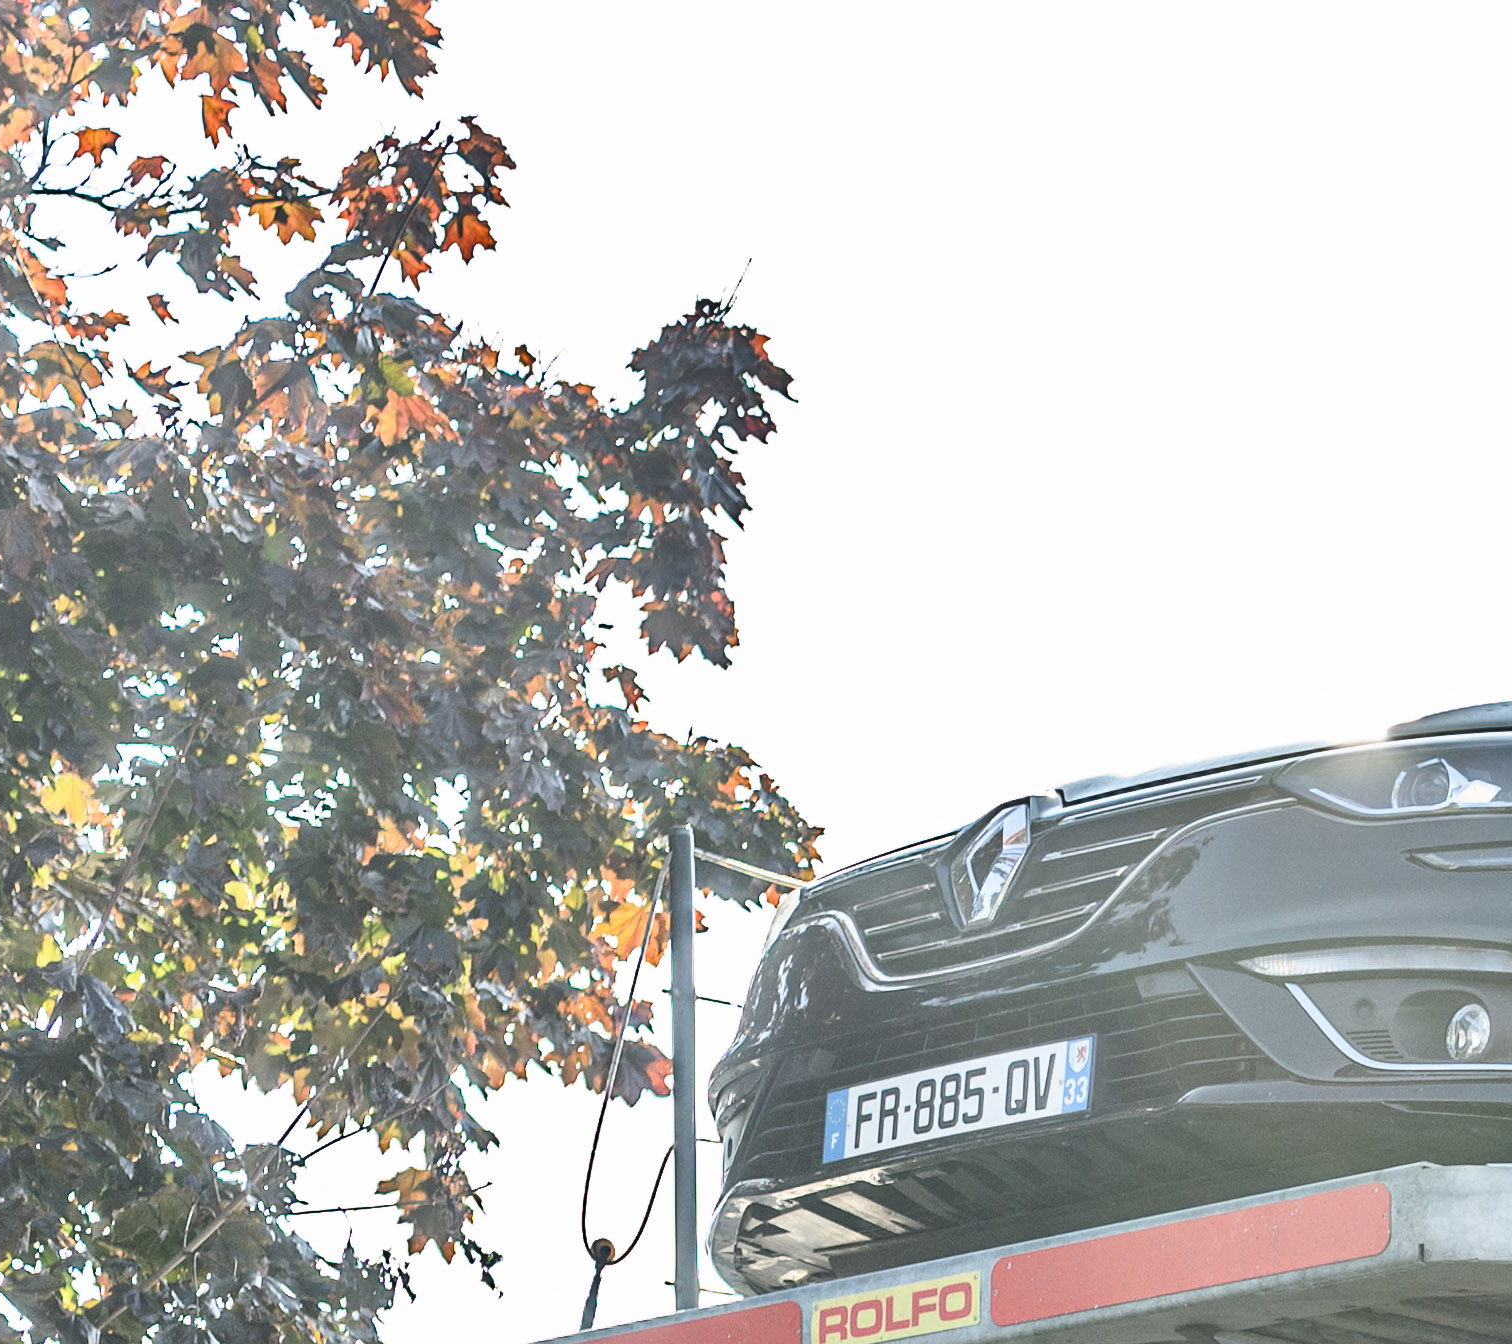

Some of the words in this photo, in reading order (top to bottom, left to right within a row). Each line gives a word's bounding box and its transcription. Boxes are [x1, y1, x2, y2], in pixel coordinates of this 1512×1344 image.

[831, 1133, 839, 1150] F
[854, 1053, 1056, 1149] FR-885-QV
[1064, 1075, 1088, 1106] 33
[819, 1282, 972, 1344] ROLFO
